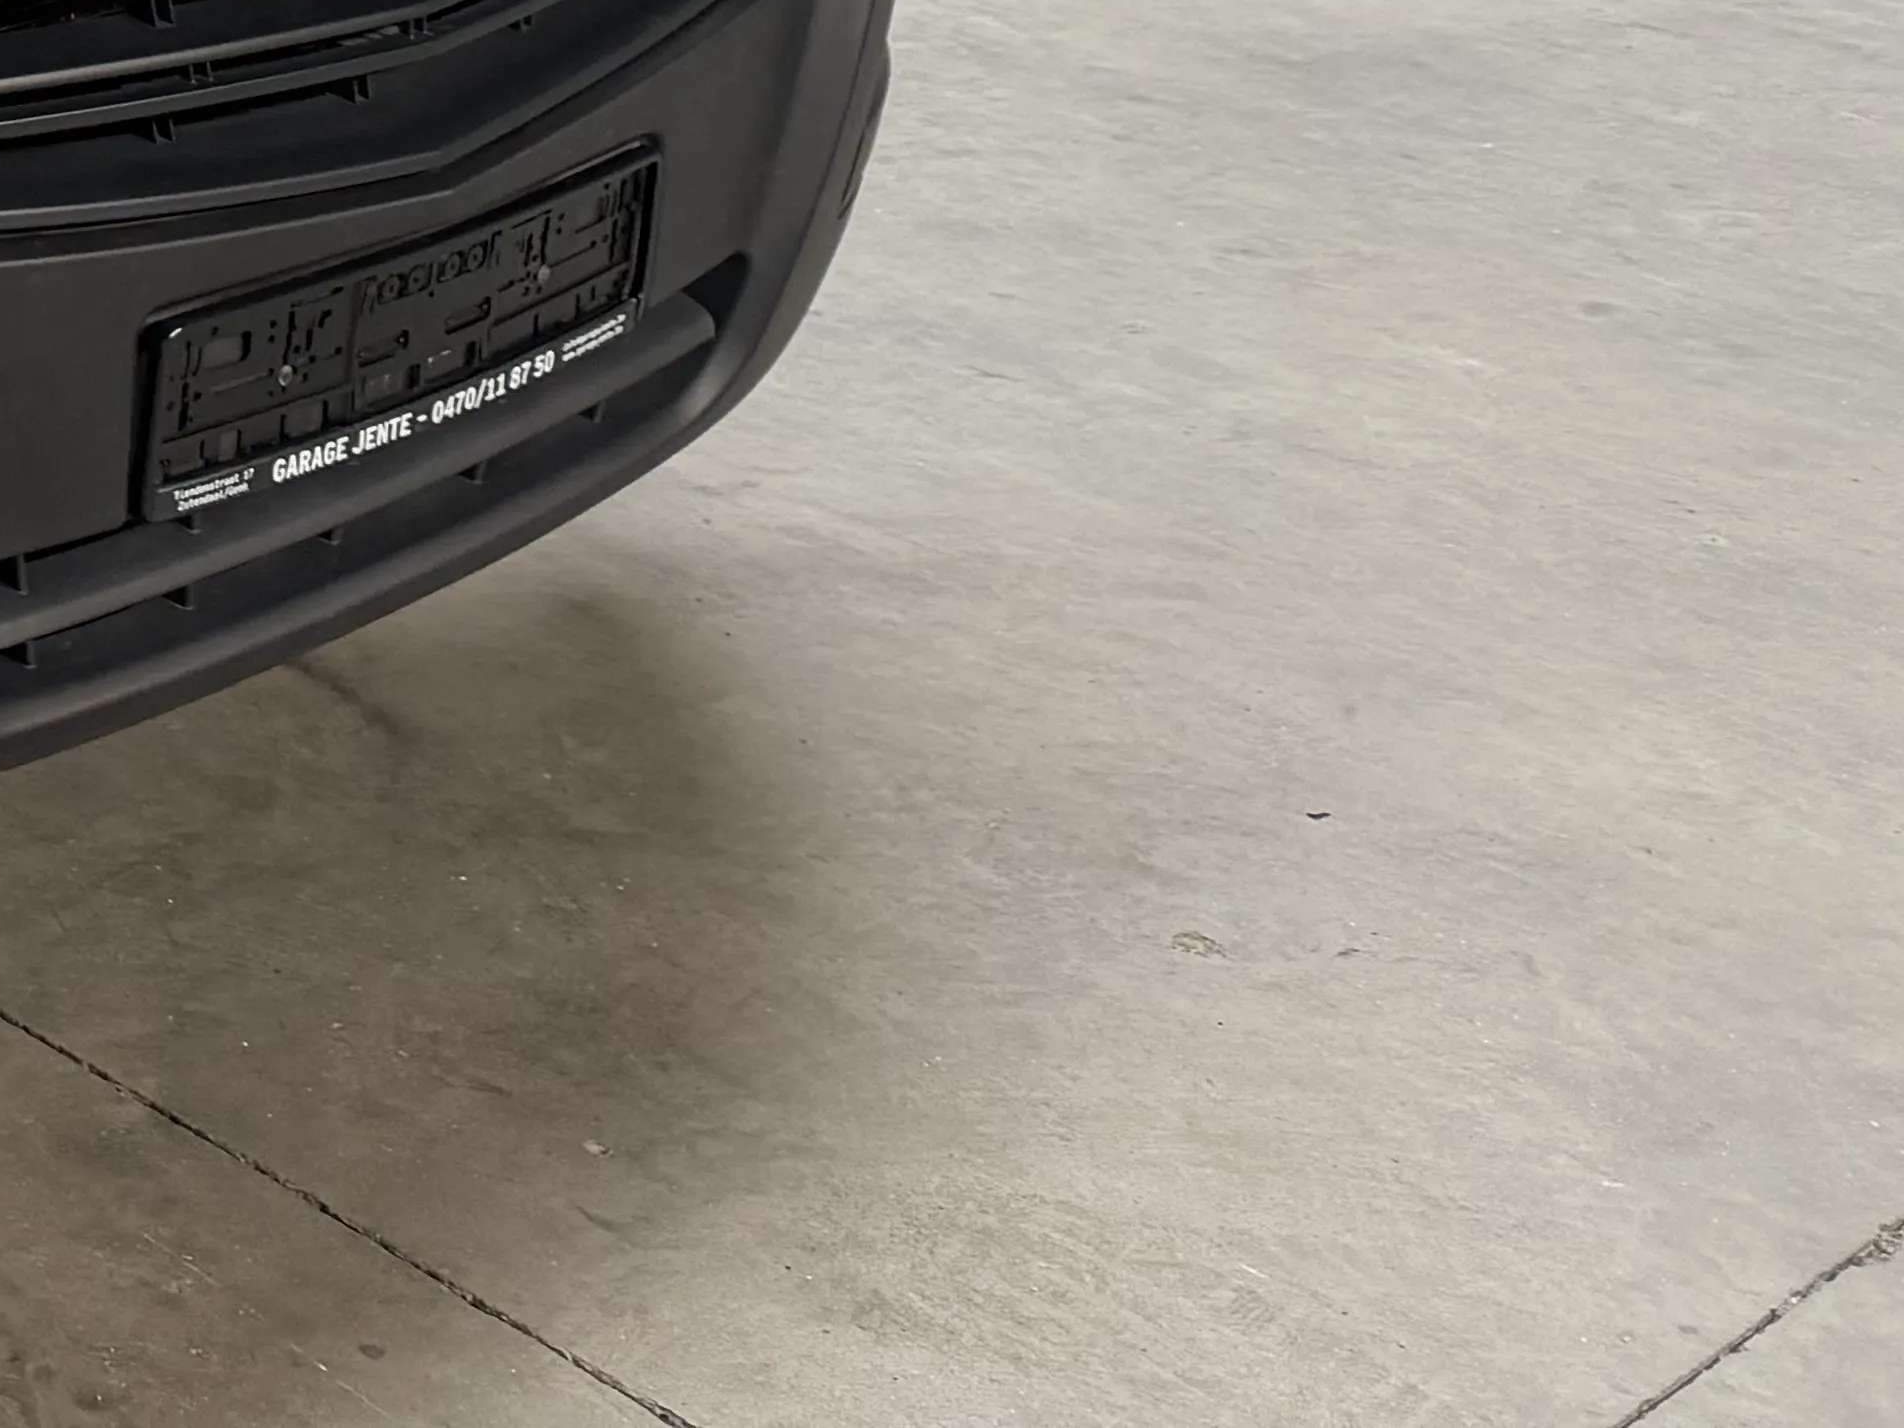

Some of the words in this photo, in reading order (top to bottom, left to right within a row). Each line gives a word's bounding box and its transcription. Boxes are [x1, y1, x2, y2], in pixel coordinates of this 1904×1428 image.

[272, 435, 350, 483] GARAGE
[351, 411, 414, 455] JENTE
[431, 375, 507, 425] 0470/11
[509, 362, 531, 390] 87
[532, 349, 556, 378] 50
